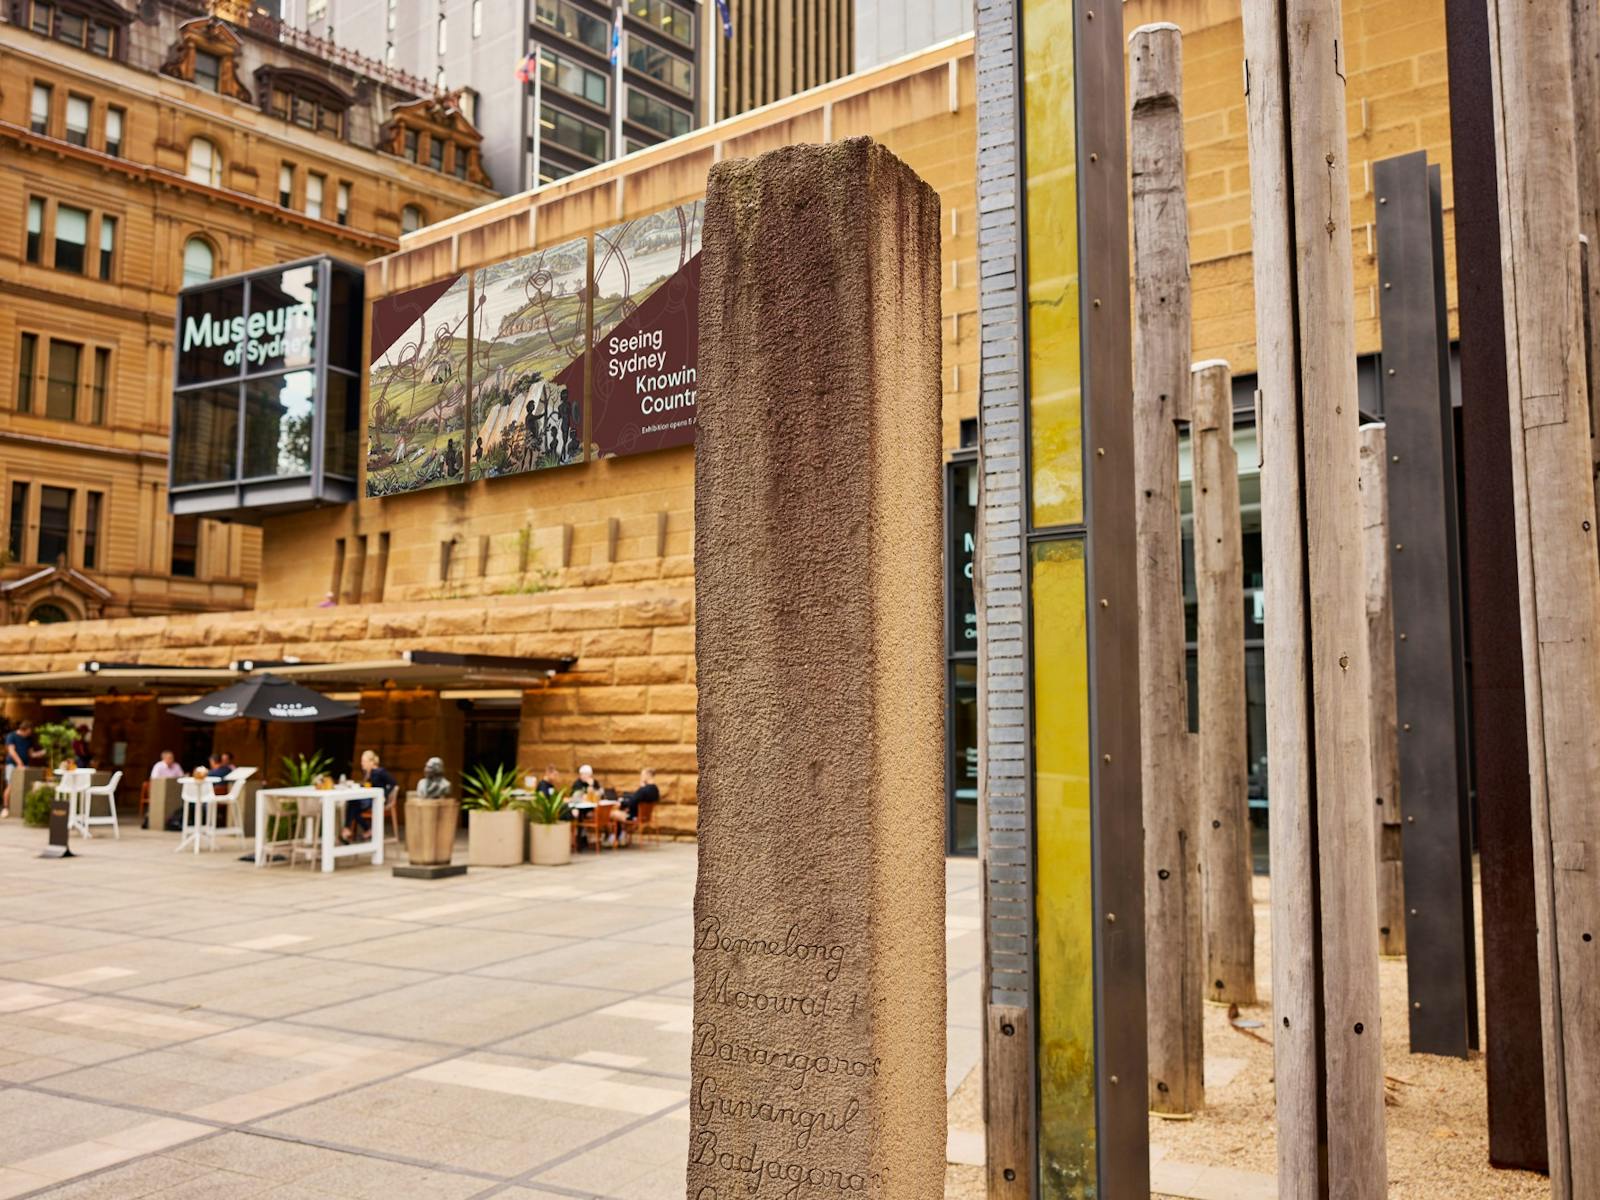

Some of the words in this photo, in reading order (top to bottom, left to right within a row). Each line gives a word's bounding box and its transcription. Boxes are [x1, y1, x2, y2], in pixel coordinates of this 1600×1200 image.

[183, 303, 314, 352] Museum
[608, 329, 663, 355] Seeing
[223, 342, 245, 366] of
[247, 334, 311, 366] Sydney
[608, 351, 667, 380] Sydney
[636, 365, 697, 395] Knowin
[641, 390, 698, 415] Countr
[641, 423, 669, 434] Exhibition
[669, 419, 687, 430] opens
[697, 915, 845, 982] Bennelong
